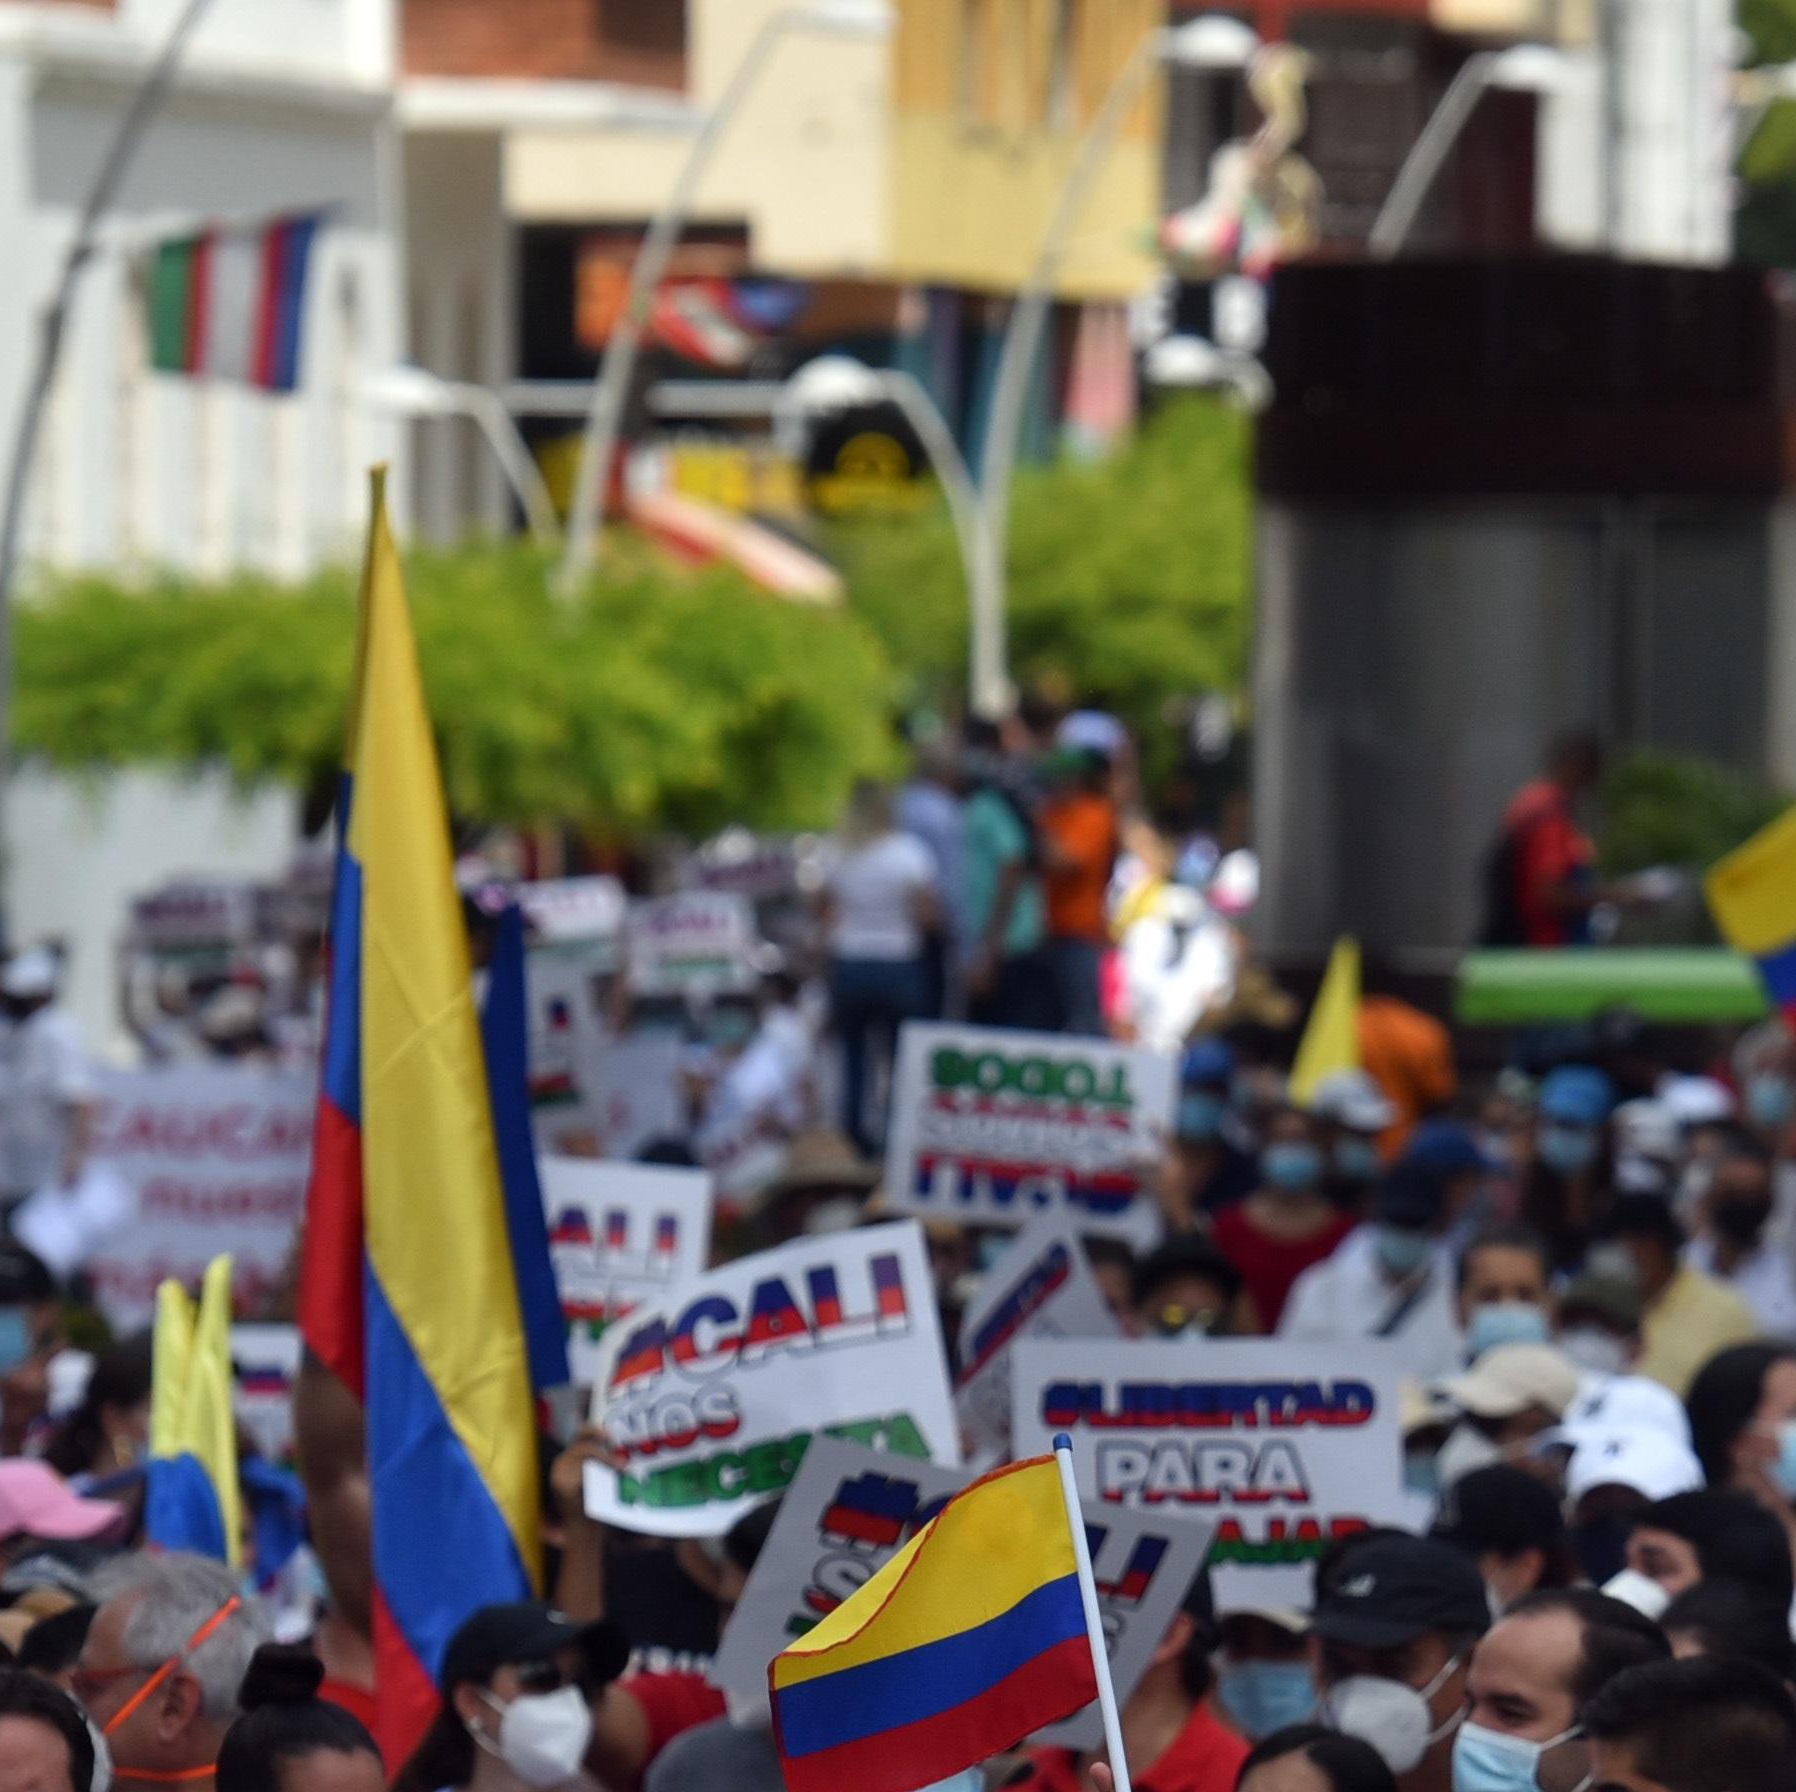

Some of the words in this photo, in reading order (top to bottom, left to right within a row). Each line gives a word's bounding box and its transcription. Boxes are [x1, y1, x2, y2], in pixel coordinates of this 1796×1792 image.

[548, 1203, 680, 1286] ALI
[609, 1253, 910, 1397] #CALI
[1042, 1380, 1375, 1428] #LIBERTAD
[1096, 1436, 1312, 1504] PARA
